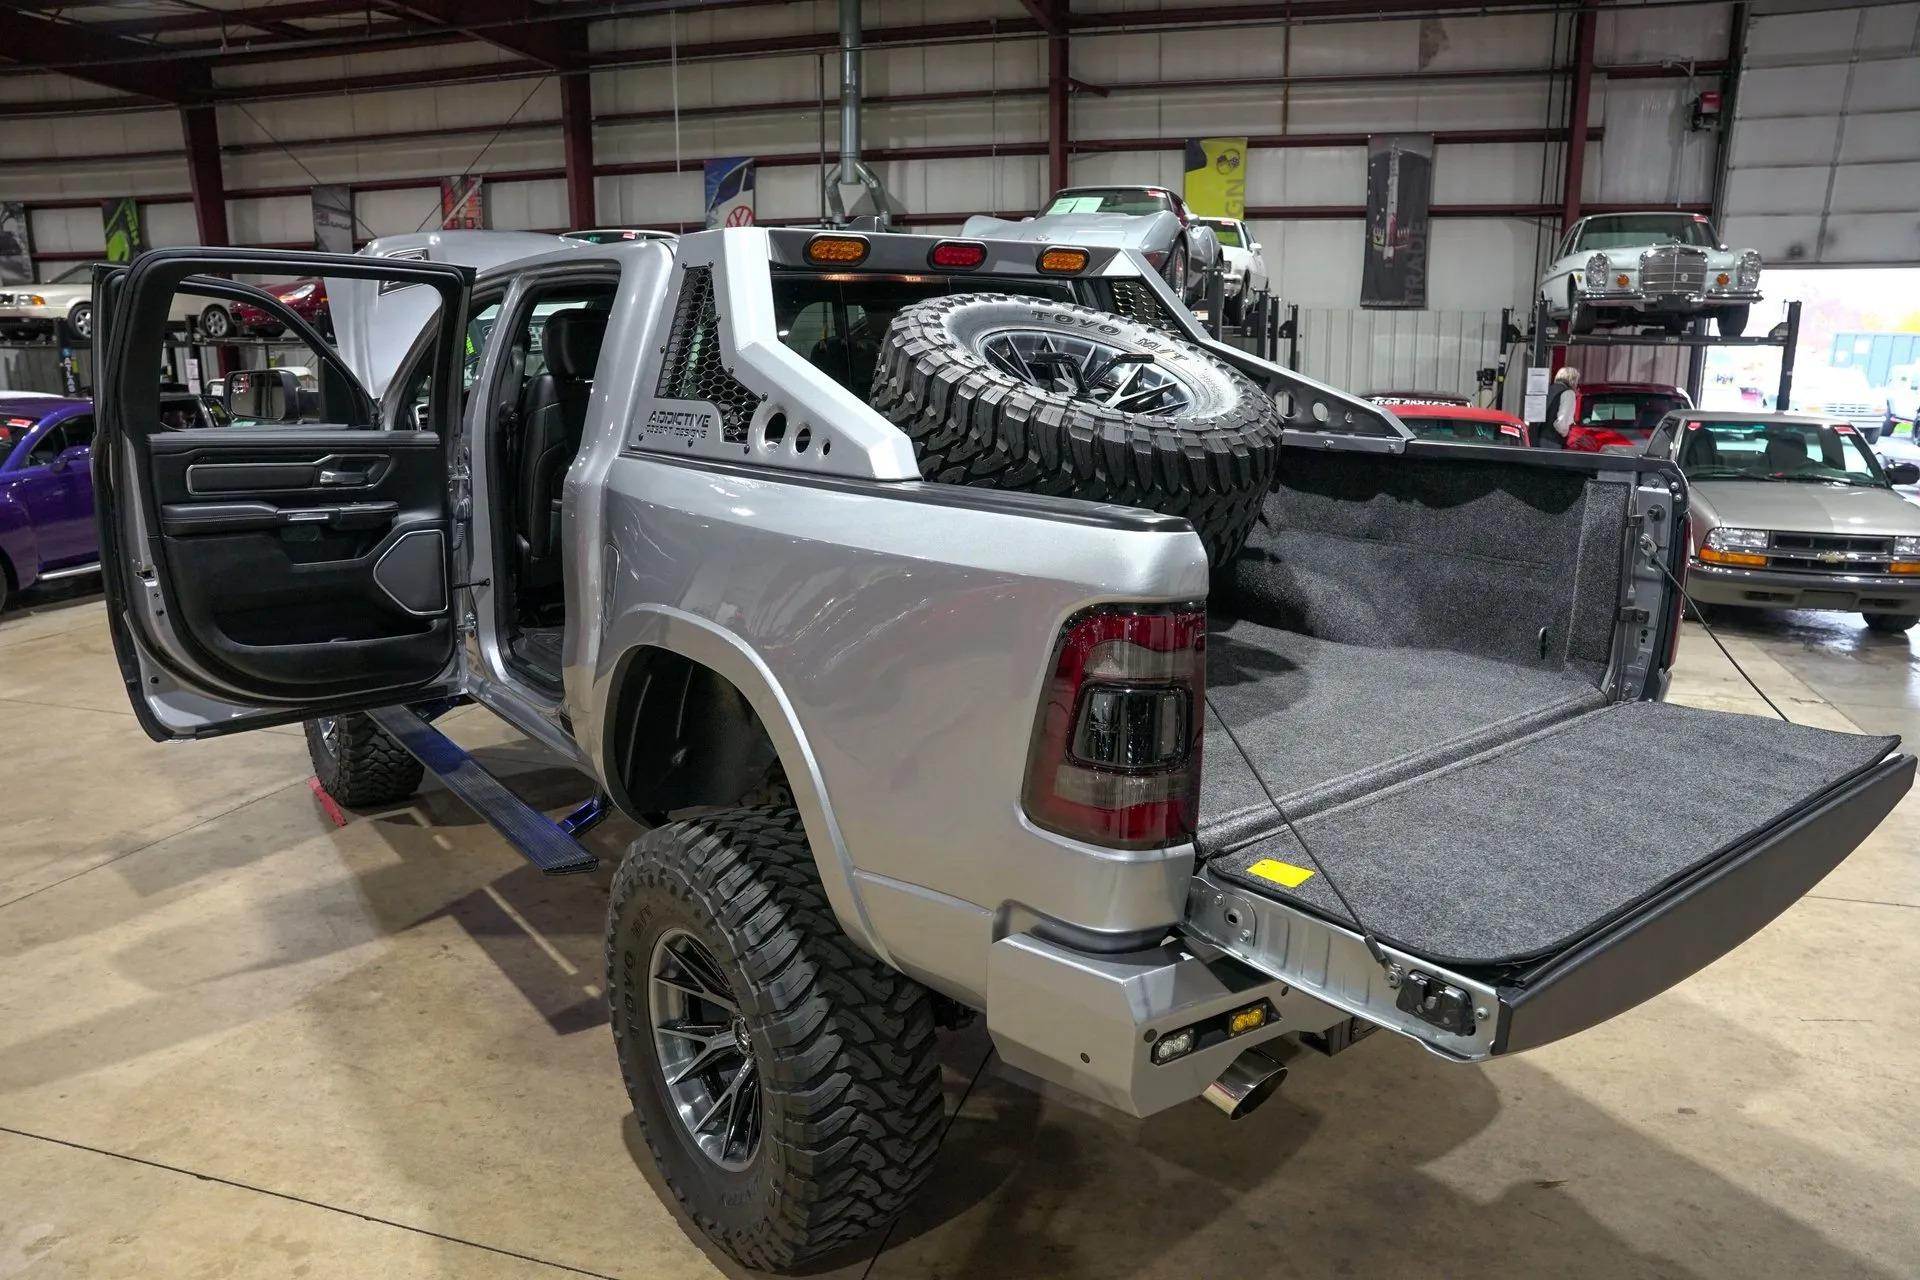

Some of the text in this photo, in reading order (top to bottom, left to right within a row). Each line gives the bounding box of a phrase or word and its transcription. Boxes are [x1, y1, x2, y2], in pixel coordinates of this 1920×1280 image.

[1404, 222, 1425, 305] TRADE
[1031, 310, 1121, 335] TOYO
[648, 410, 712, 428] ADDICTIVE
[646, 424, 707, 439] DESERT DESIGNS
